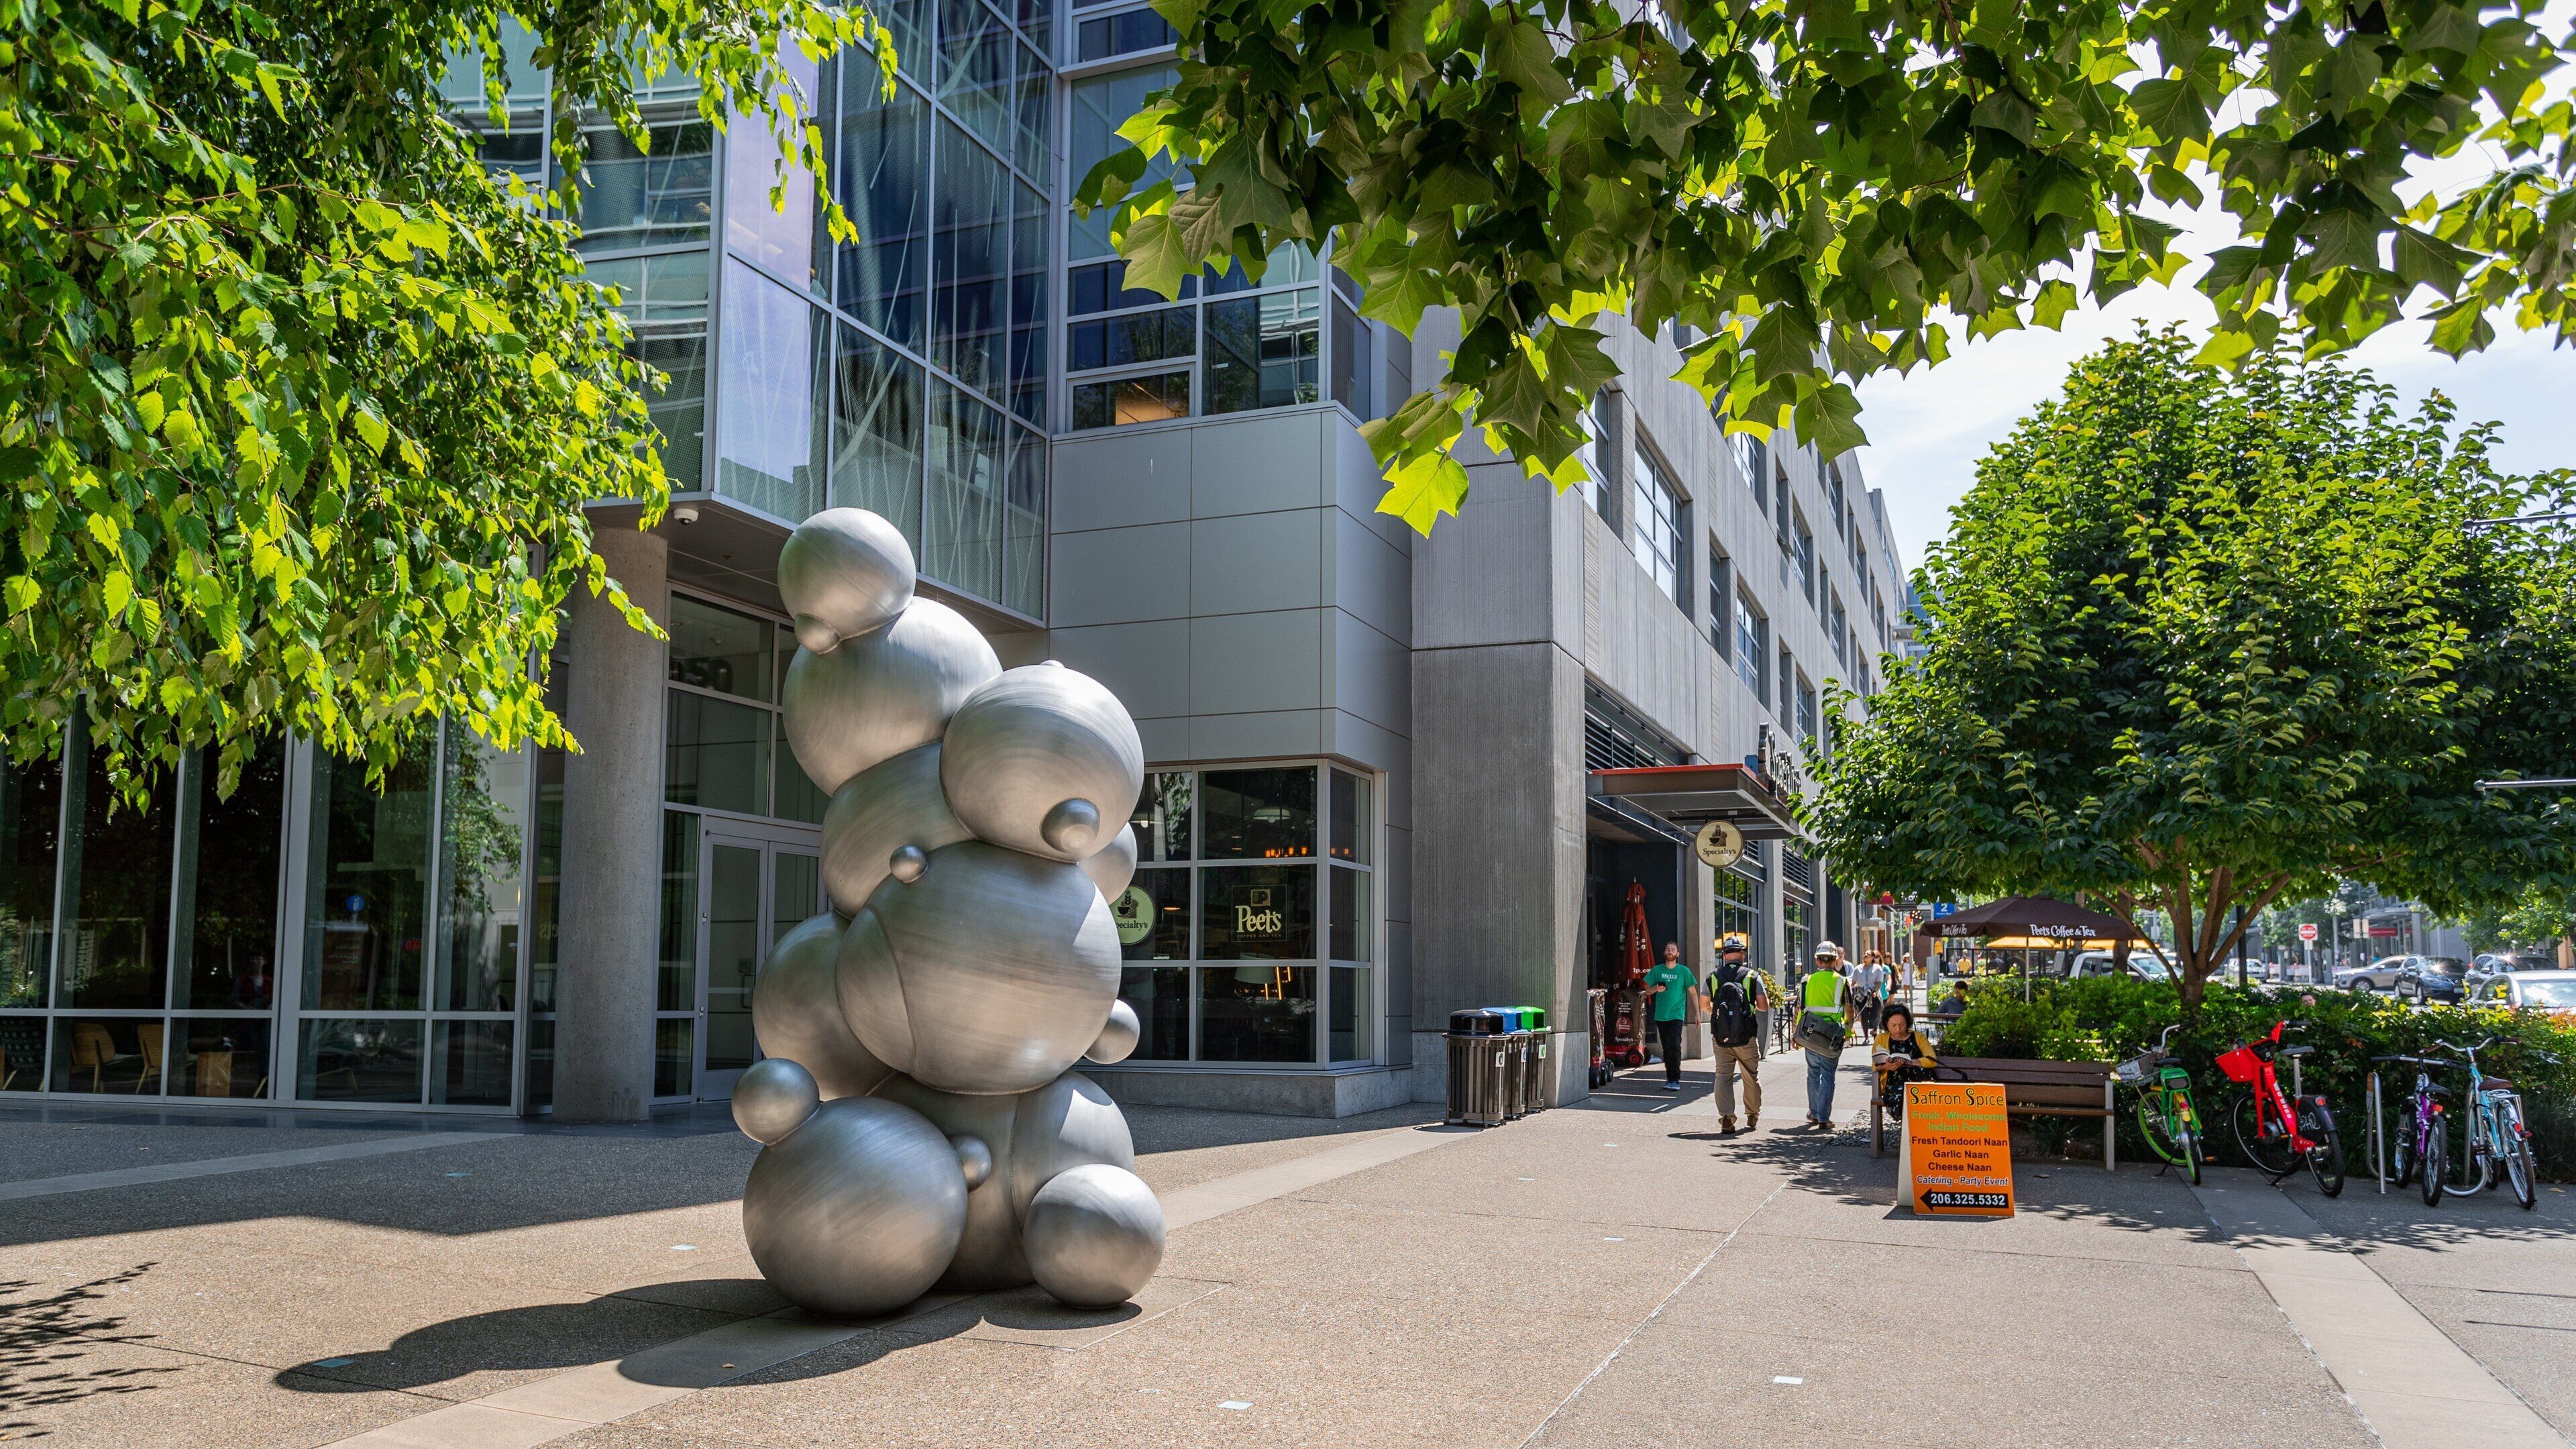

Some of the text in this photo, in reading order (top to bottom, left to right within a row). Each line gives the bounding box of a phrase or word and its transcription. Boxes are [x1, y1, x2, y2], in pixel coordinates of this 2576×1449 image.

[1703, 847, 1737, 857] Specialty's
[1235, 905, 1282, 933] Peet's
[1116, 920, 1148, 931] pecialty's
[2051, 924, 2074, 938] Coffee
[2079, 925, 2096, 937] Tea
[1910, 1087, 2004, 1108] Saffron Spice
[1947, 1112, 2005, 1121] Wholesome
[1929, 1123, 1988, 1132] Indian Food
[1912, 1136, 2008, 1146] Fresh Tandoori Naan
[1933, 1149, 1989, 1159] Garlic Naan
[1928, 1162, 1992, 1172] Cheese Naan
[1917, 1175, 1952, 1186] Catering
[1960, 1176, 1982, 1186] Party
[1984, 1177, 2008, 1186] Event
[1931, 1193, 2005, 1205] 206.325.5332
